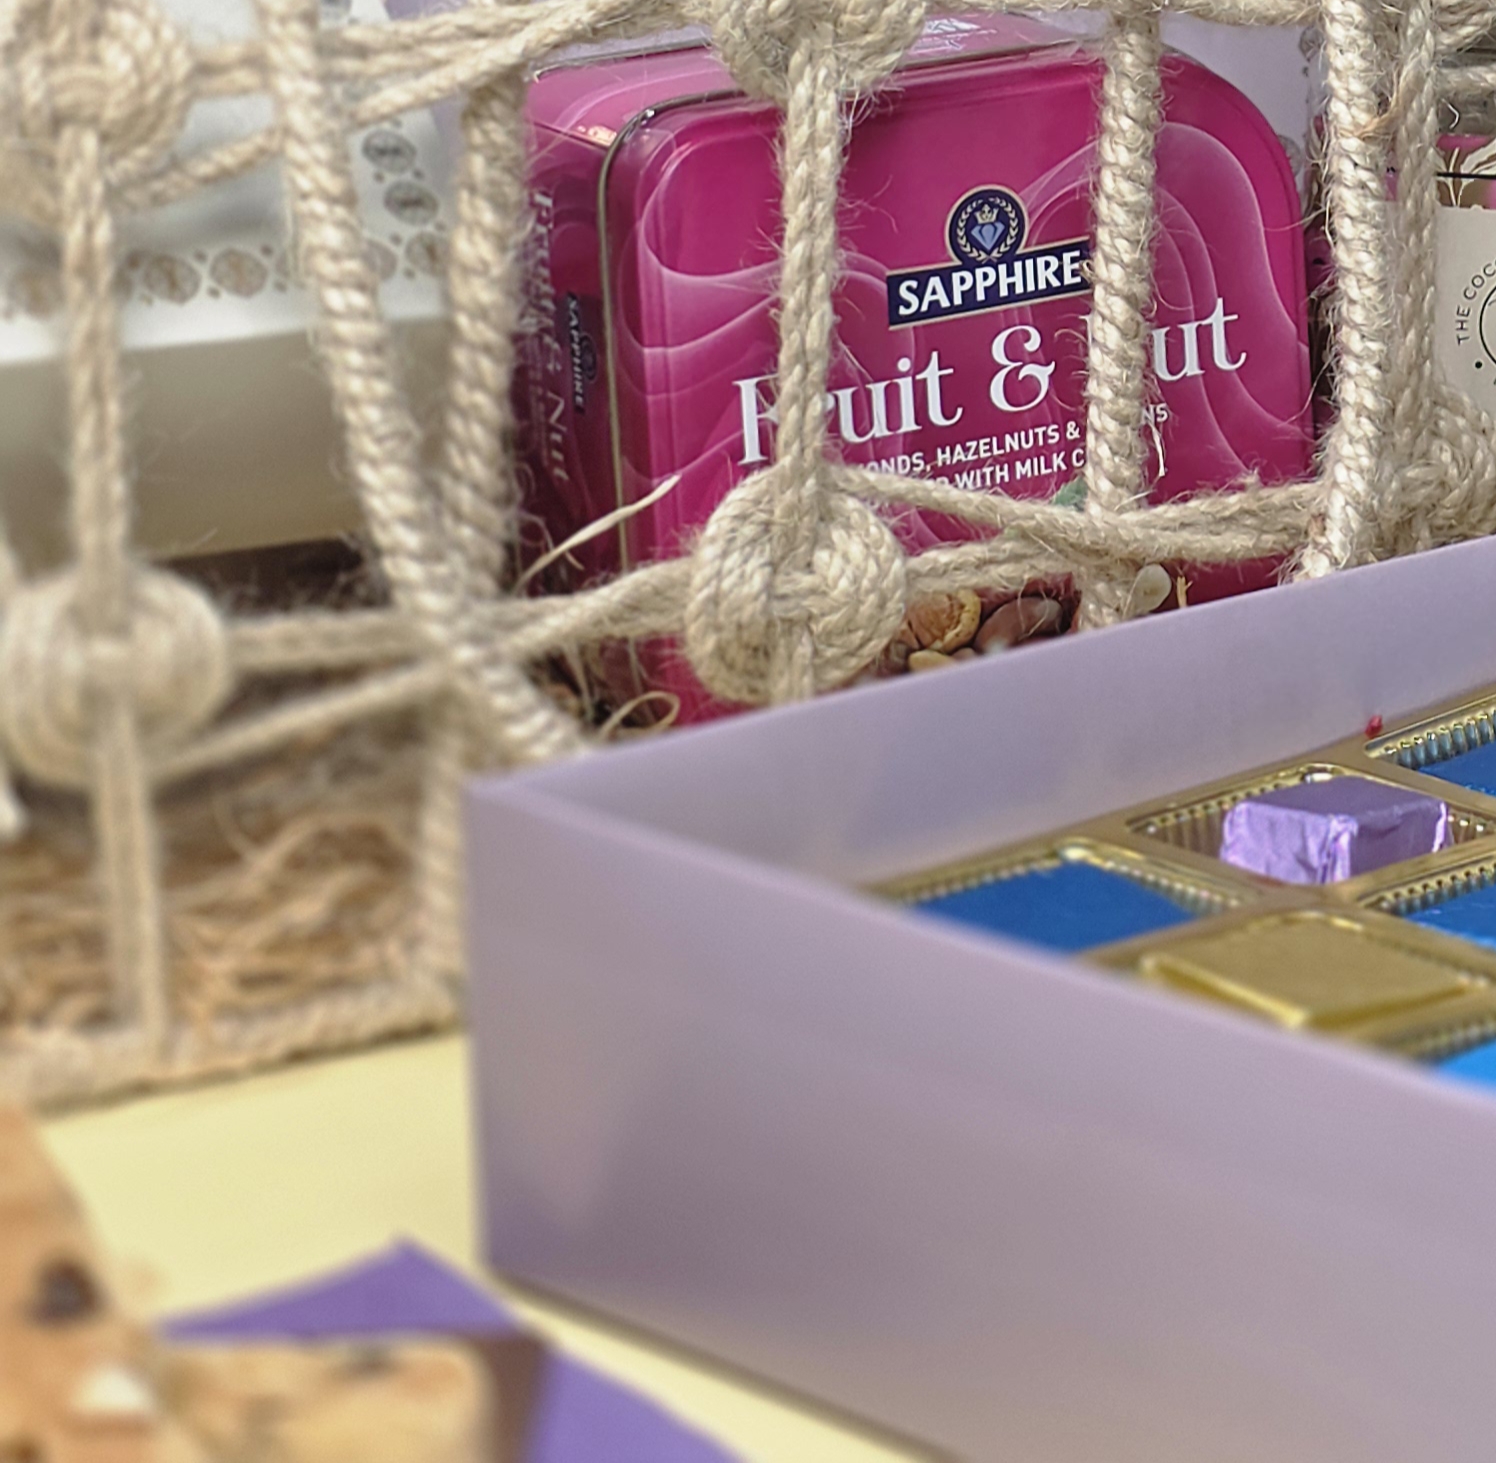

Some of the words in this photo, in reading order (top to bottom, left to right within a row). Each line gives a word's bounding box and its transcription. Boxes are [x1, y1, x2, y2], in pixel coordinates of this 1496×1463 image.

[898, 250, 1082, 316] SAPPHIRE
[567, 296, 584, 408] SAPPHIRE
[1456, 305, 1471, 346] THE
[732, 351, 964, 465] Fuit
[989, 325, 1056, 412] &
[1079, 297, 1247, 382] ut
[546, 391, 569, 482] Nut
[937, 424, 1060, 466] HAZELNUTS
[1066, 420, 1081, 440] &
[954, 462, 1010, 490] WITH
[1015, 450, 1067, 481] MILK
